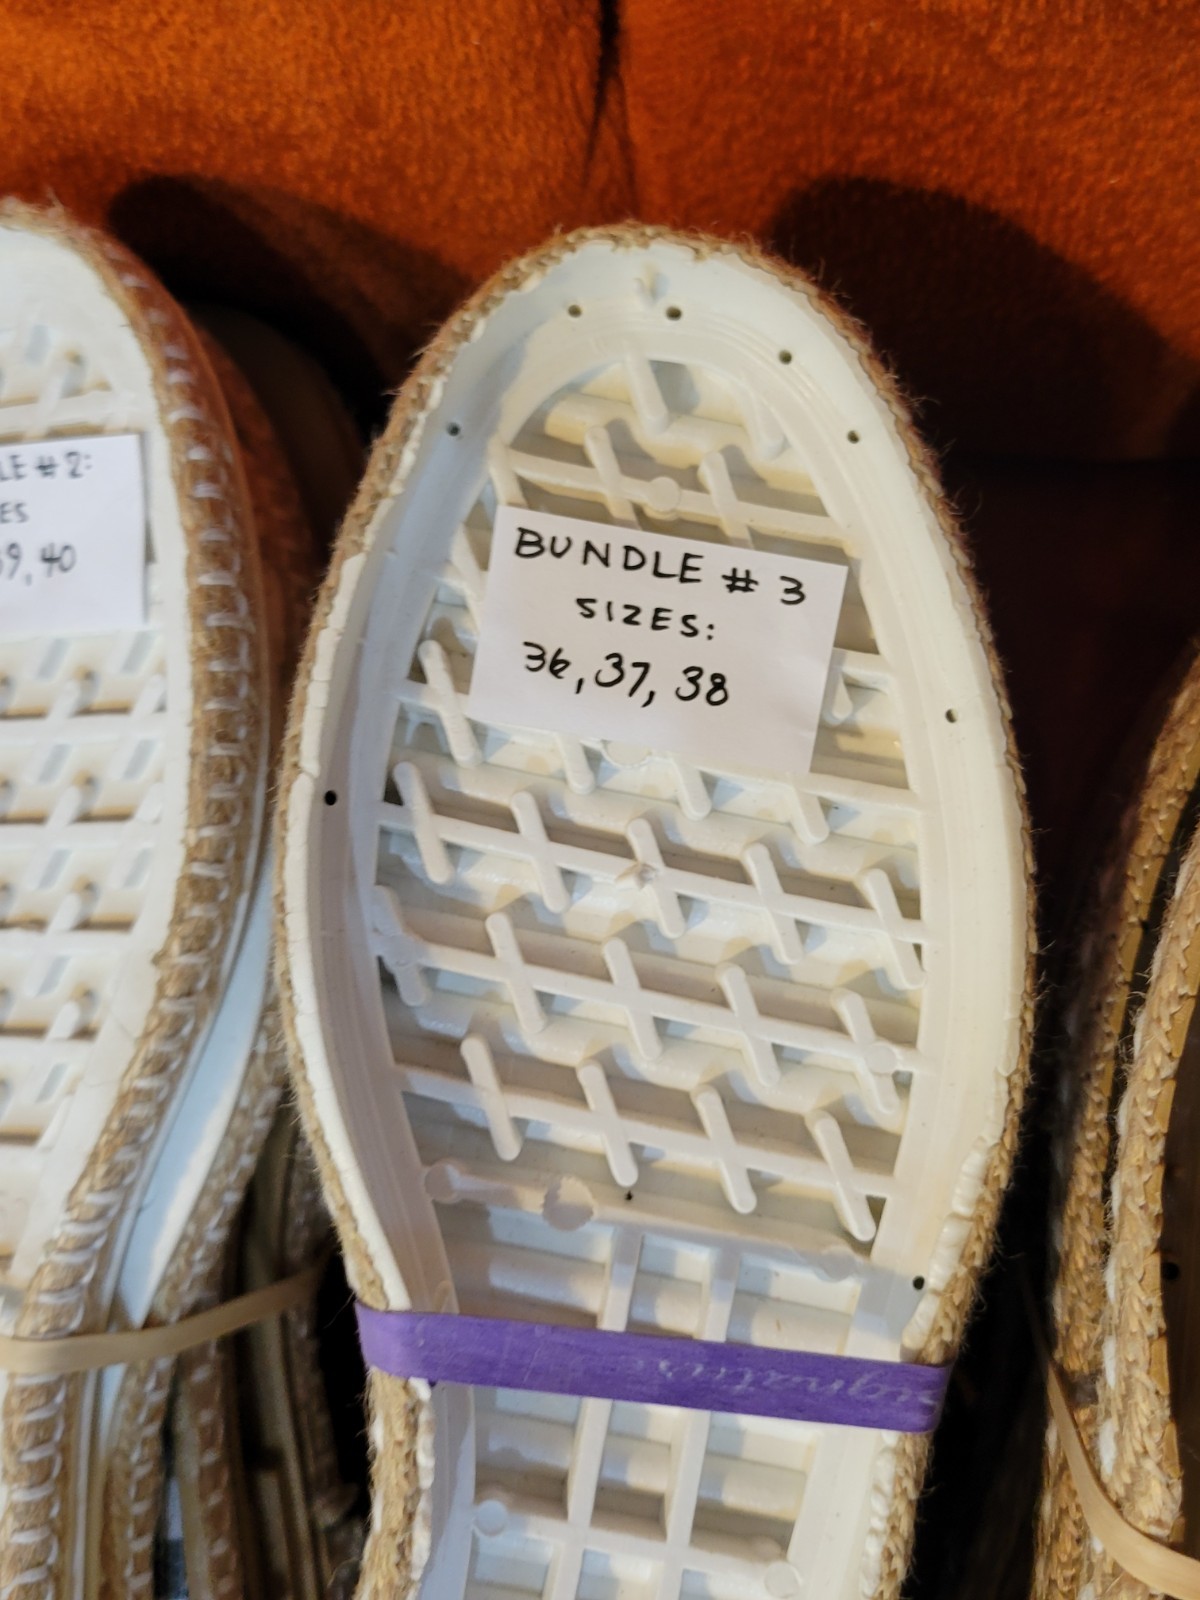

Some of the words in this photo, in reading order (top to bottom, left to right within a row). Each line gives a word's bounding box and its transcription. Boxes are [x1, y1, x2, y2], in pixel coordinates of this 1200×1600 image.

[0, 542, 32, 587] 9,
[41, 542, 77, 578] 40
[514, 526, 704, 584] BUNDLE
[721, 567, 759, 593] #
[779, 575, 806, 605] 3
[575, 598, 715, 640] SIZES:
[594, 652, 656, 708] 37,
[675, 665, 729, 706] 38
